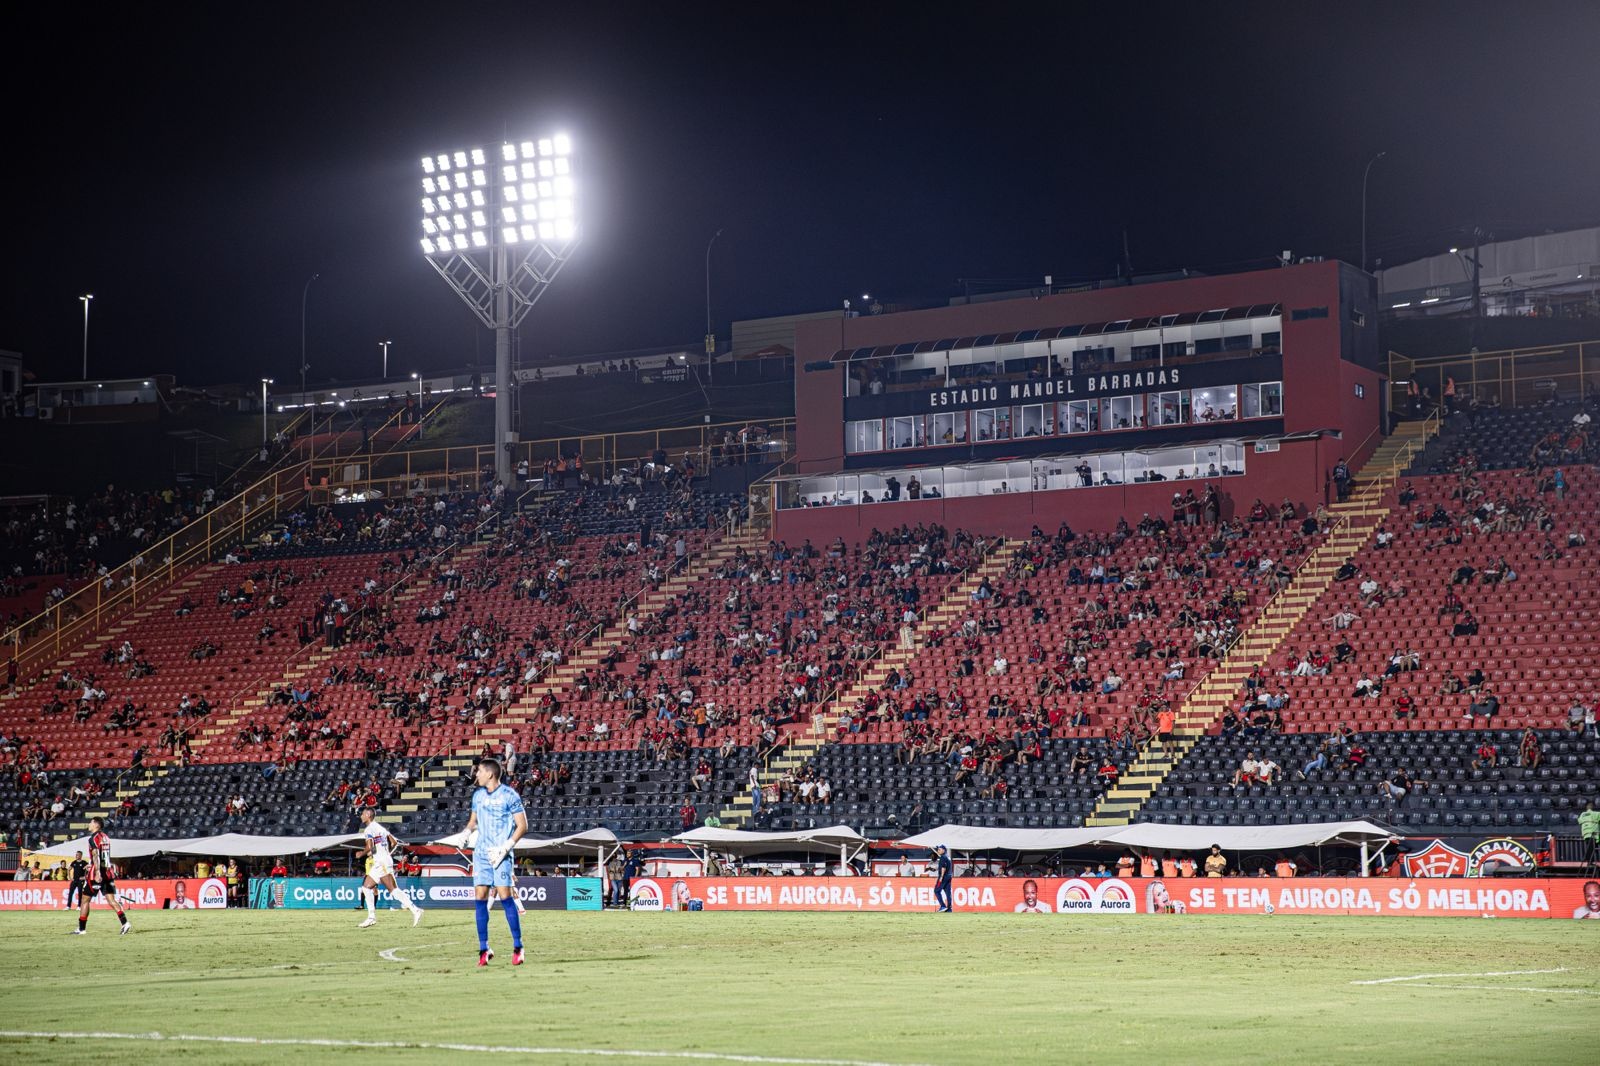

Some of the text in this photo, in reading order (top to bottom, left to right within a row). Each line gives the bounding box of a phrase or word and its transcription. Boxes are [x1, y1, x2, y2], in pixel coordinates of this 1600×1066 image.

[931, 369, 1180, 407] ESTADIO MANOEL BARRADAS
[203, 896, 224, 904] Aurora
[294, 886, 332, 904] Copa
[335, 885, 355, 901] do
[706, 881, 996, 909] SE TEM AURORA, SÓ MELORA
[1189, 881, 1550, 913] SE TEM AURORA, SÓ MELHORA
[634, 898, 659, 906] Aurora
[1063, 900, 1092, 909] Aurora
[1100, 900, 1131, 909] Aurora
